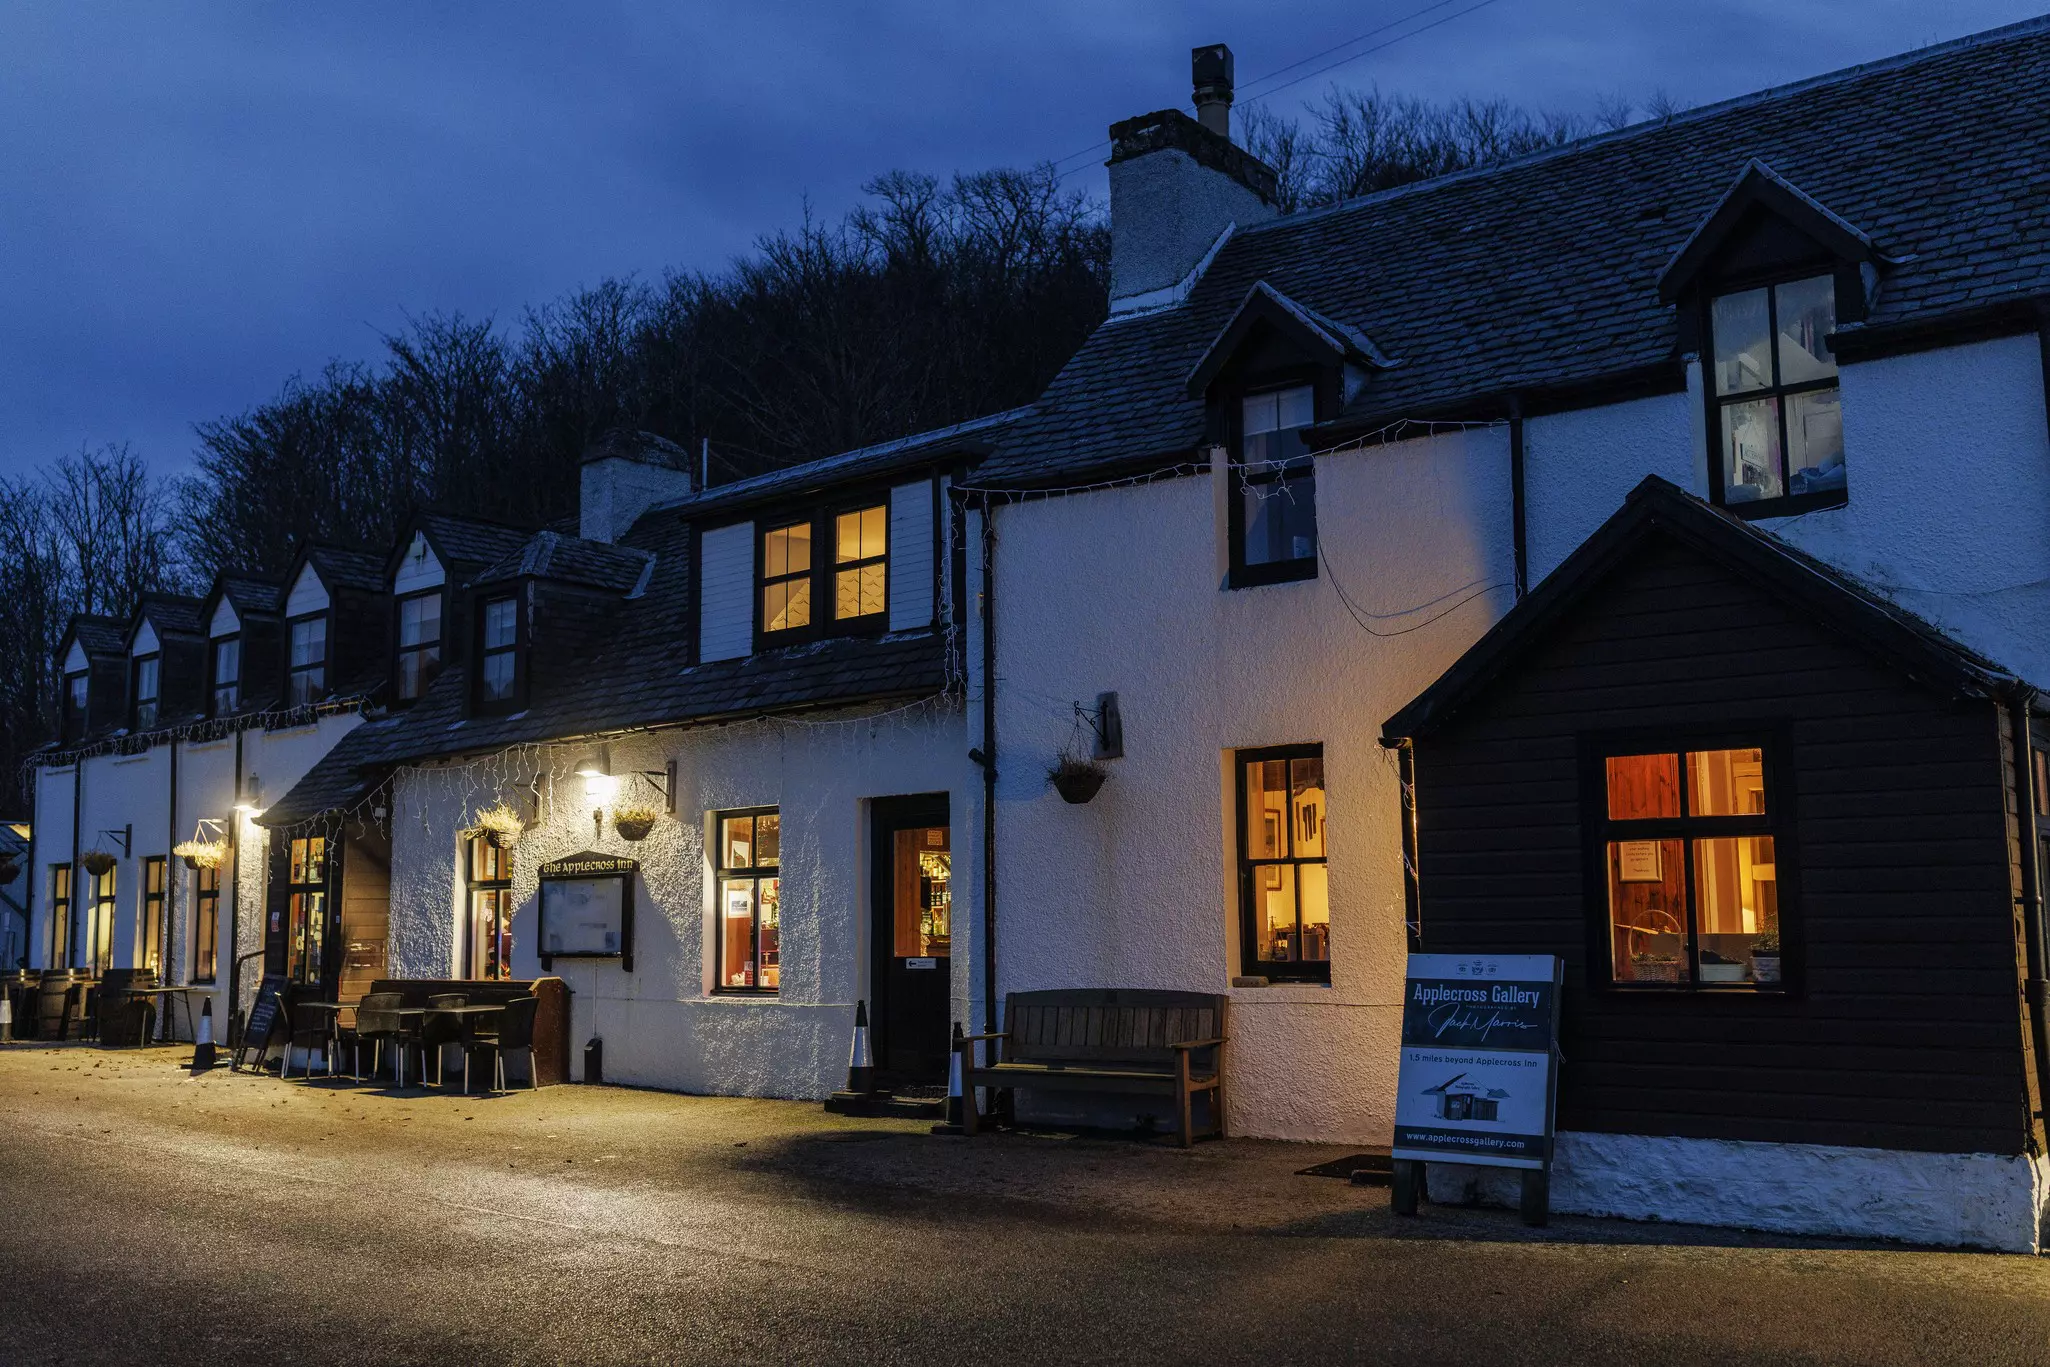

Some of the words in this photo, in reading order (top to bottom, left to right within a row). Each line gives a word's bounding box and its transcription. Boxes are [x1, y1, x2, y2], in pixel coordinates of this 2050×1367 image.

[543, 862, 561, 873] The
[562, 860, 615, 874] Applecross
[617, 858, 633, 869] Inn
[1413, 983, 1487, 1006] Applecross
[1492, 985, 1540, 1009] Gallery
[1409, 1053, 1420, 1062] 1.5
[1422, 1054, 1443, 1063] miles
[1444, 1055, 1474, 1065] beyond
[1476, 1057, 1521, 1067] Applecross
[1524, 1058, 1538, 1067] Inn
[1406, 1132, 1525, 1149] www.applecrossgallery.com
